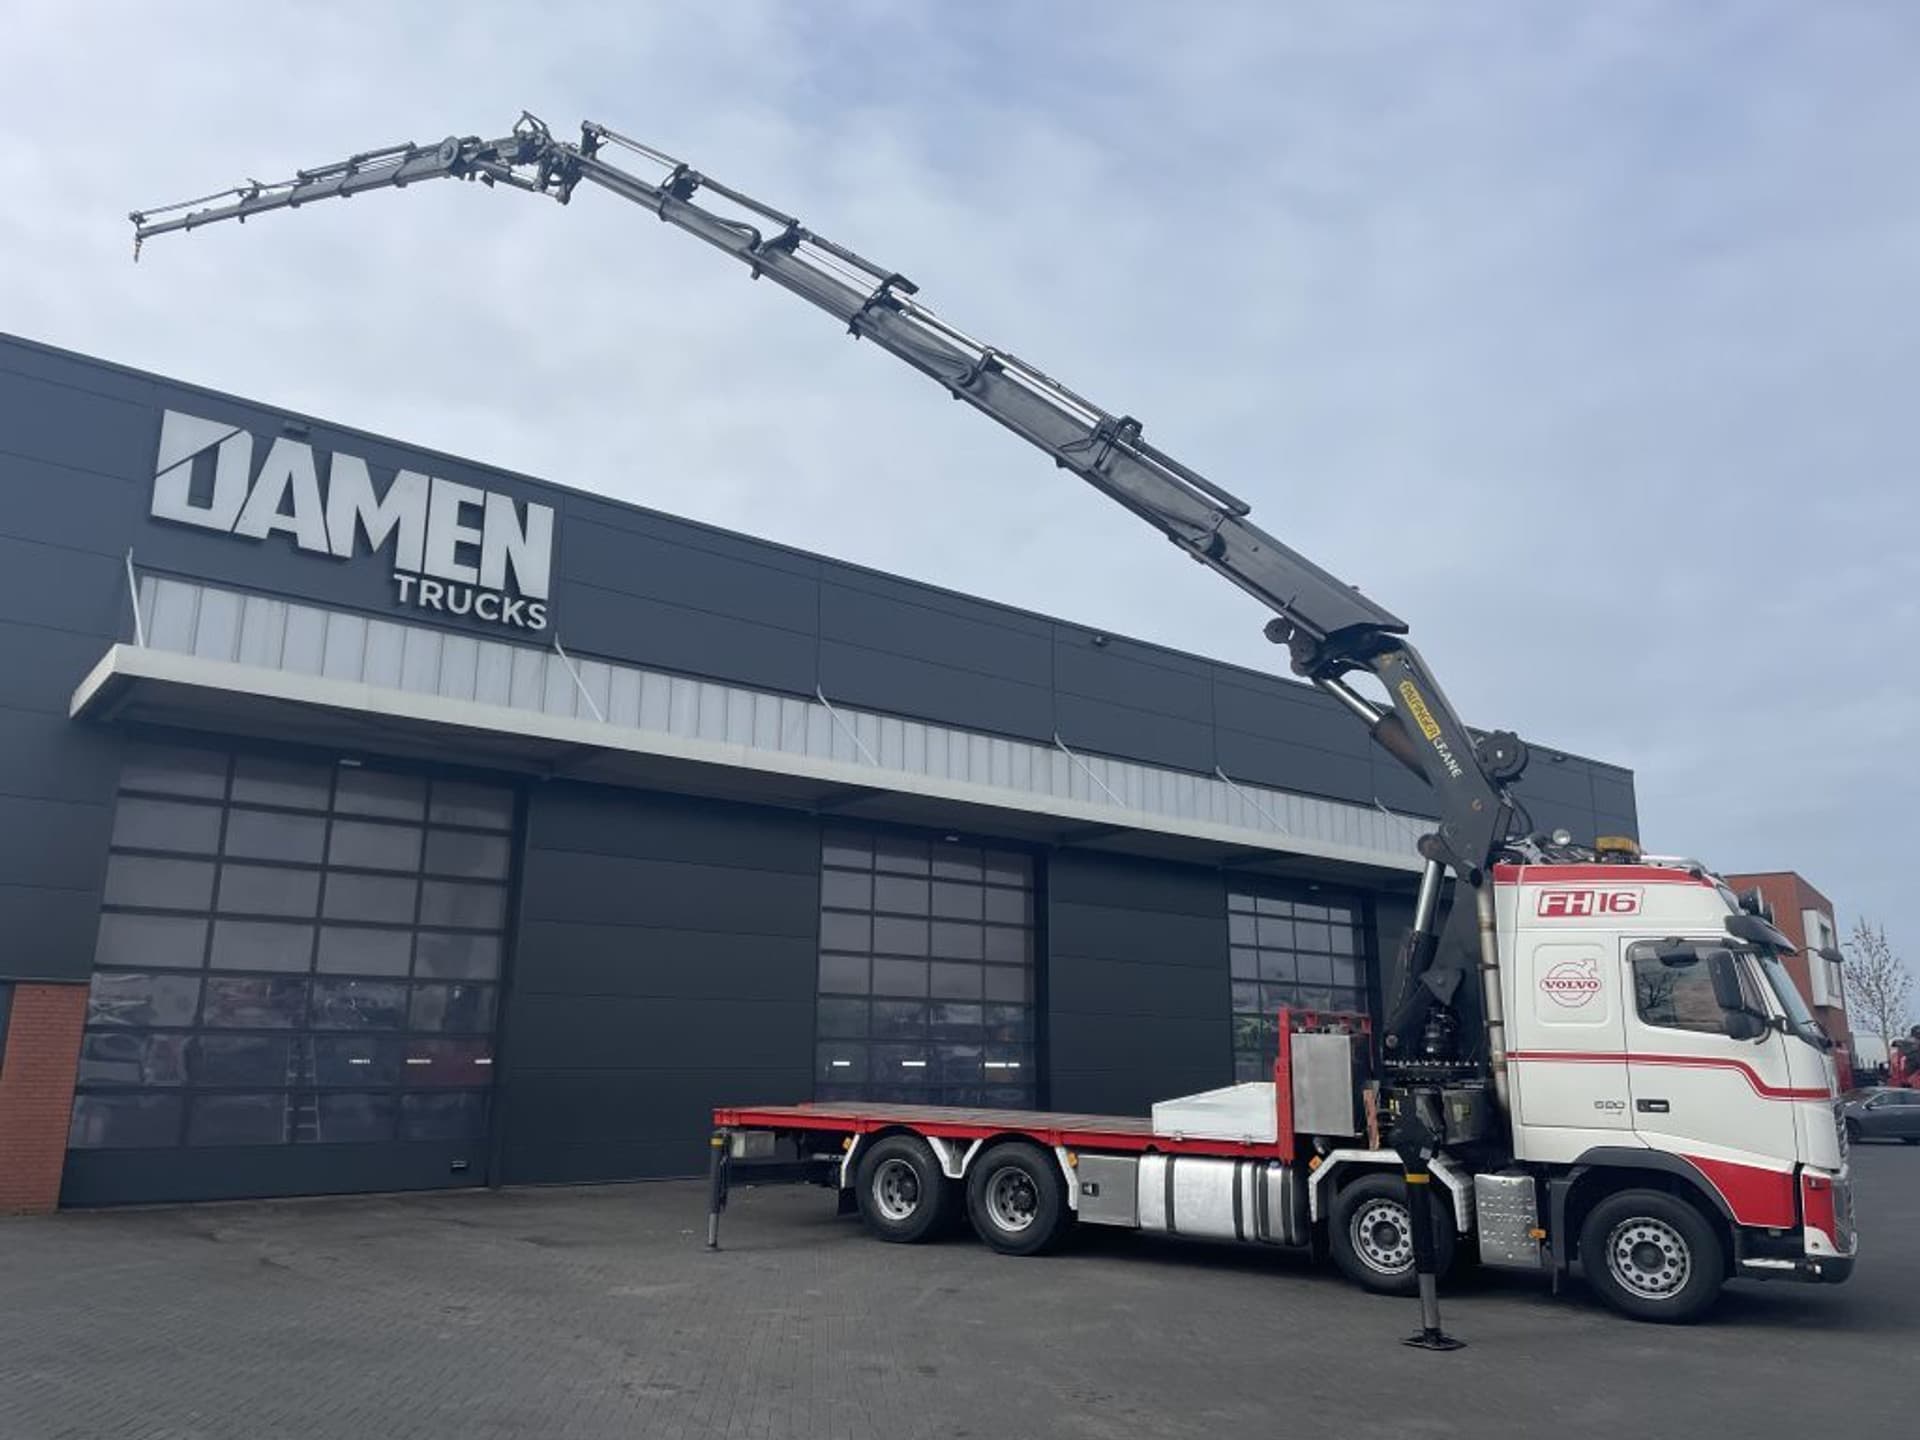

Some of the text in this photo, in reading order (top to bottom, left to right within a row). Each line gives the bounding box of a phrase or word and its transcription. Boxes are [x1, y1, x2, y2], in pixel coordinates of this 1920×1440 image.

[151, 408, 555, 601] DAMEN
[393, 572, 548, 631] TRUCKS
[1544, 980, 1599, 990] VOLVO
